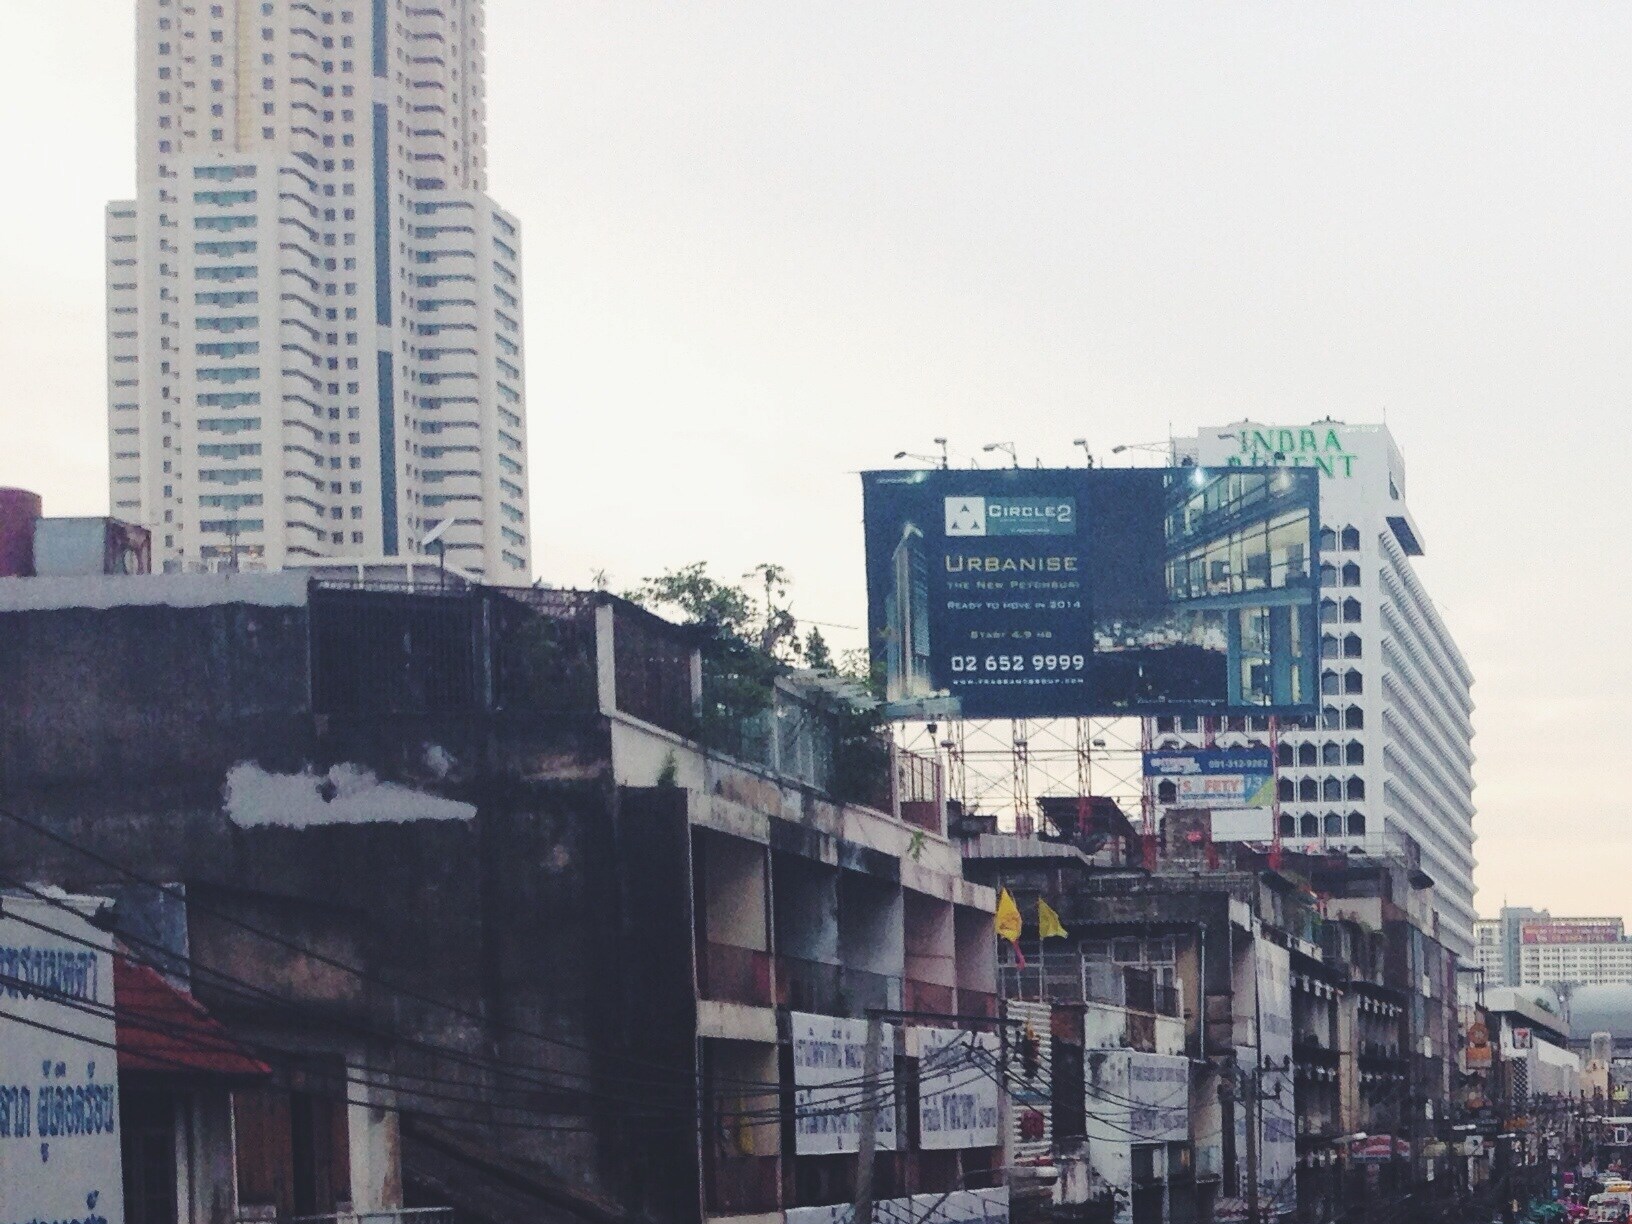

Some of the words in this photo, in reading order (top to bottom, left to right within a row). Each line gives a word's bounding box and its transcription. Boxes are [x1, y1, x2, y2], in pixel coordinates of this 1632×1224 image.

[1239, 428, 1342, 453] INDRA
[1050, 601, 1081, 609] 2014
[951, 656, 977, 672] 02
[985, 655, 1024, 671] 652
[1032, 654, 1084, 671] 9999
